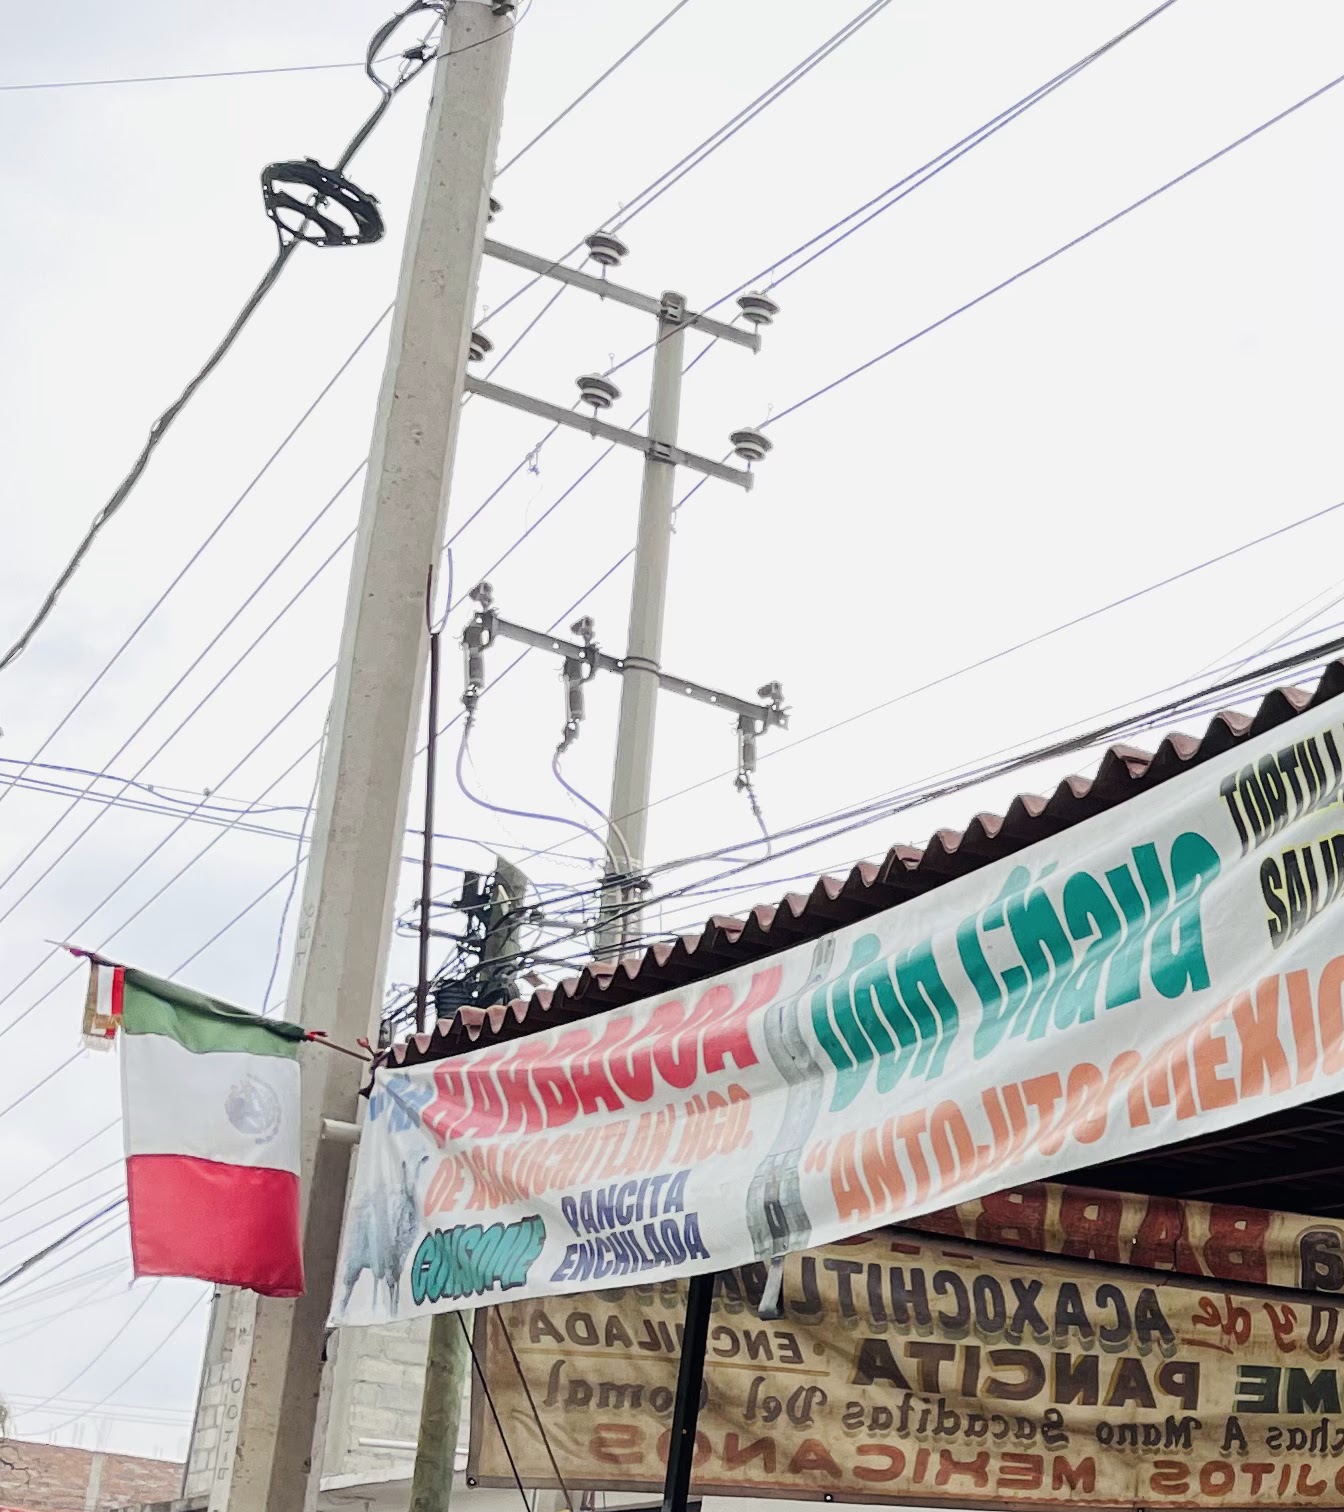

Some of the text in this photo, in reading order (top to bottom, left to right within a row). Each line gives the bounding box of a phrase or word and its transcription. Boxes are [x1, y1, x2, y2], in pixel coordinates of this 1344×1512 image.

[810, 933, 960, 1113] Don
[560, 1168, 692, 1238] PANCITA
[549, 1212, 711, 1283] ENCHILADA
